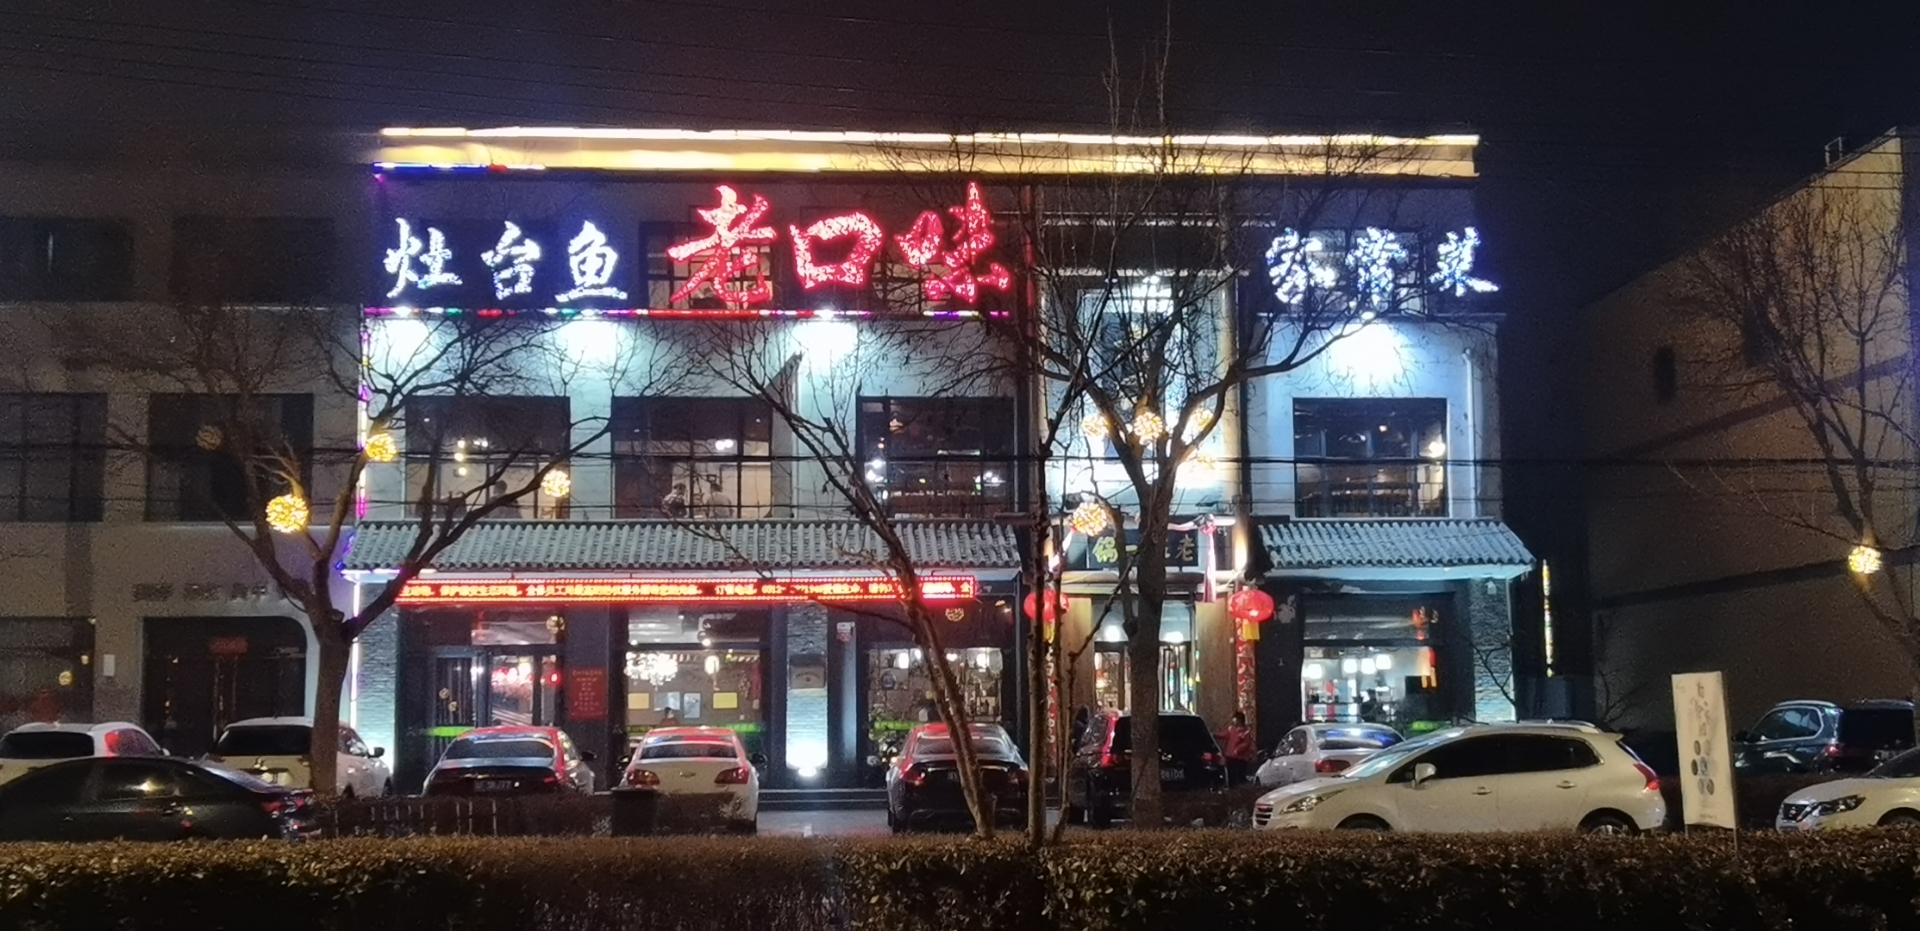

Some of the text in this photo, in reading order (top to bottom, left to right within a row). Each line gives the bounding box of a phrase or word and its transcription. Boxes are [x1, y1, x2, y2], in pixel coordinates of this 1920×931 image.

[383, 217, 628, 302] 灶台鱼
[664, 181, 1012, 304] 老口味
